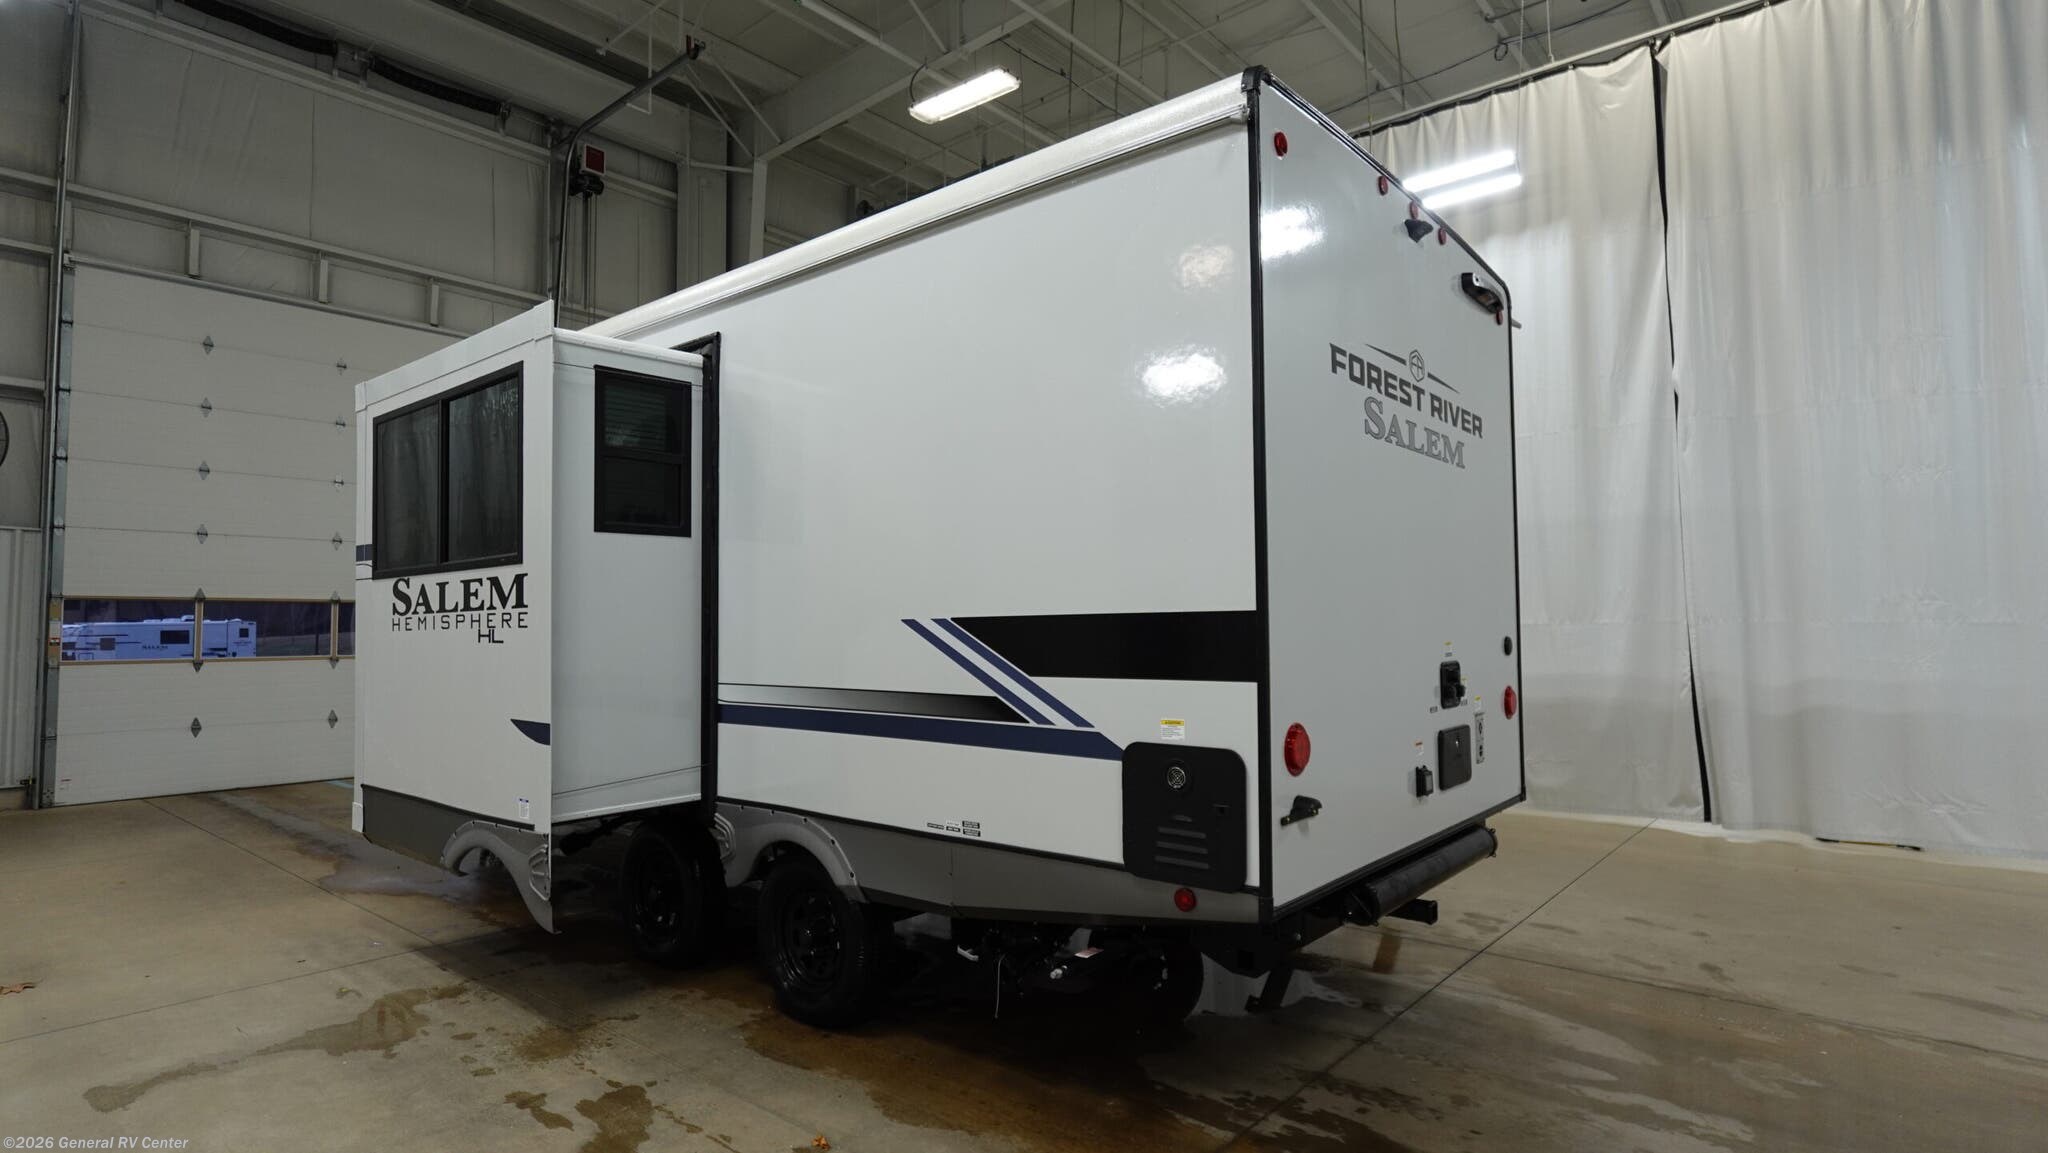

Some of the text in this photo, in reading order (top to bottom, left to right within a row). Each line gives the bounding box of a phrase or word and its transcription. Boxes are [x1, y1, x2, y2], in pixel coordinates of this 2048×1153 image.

[1329, 342, 1483, 439] FOREST RIVER
[1364, 396, 1466, 469] SALEM
[392, 573, 529, 616] SALEM
[392, 612, 528, 632] HEMISPHERE
[478, 629, 504, 644] HL
